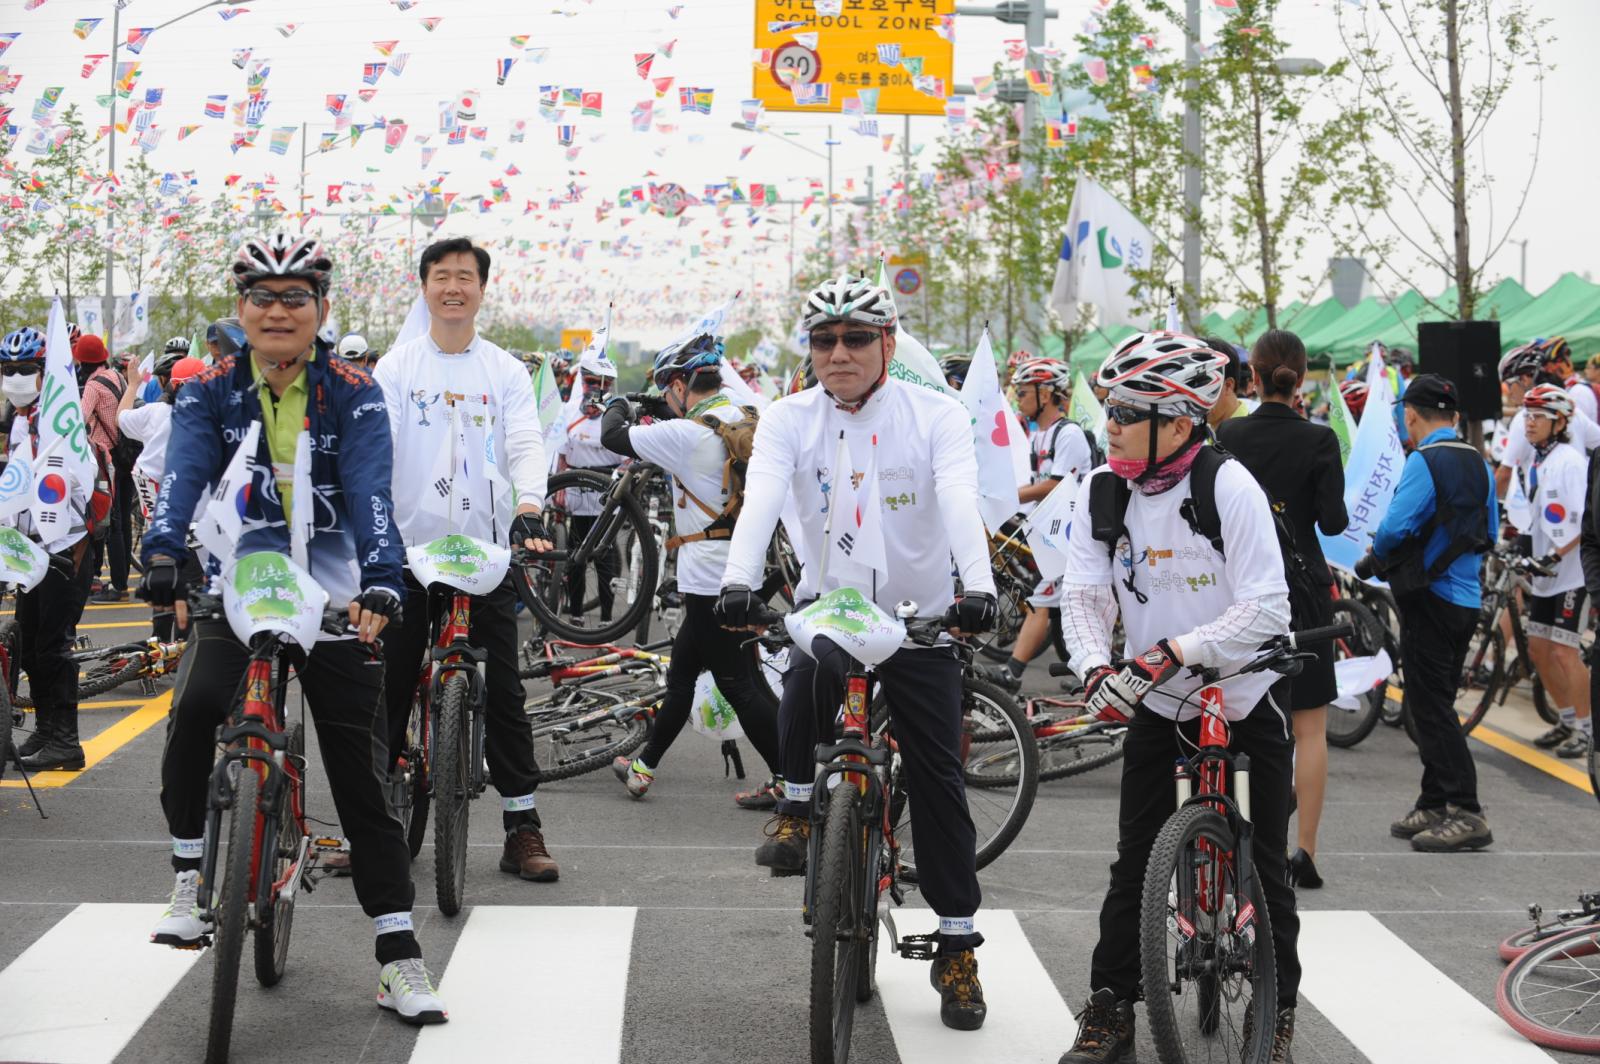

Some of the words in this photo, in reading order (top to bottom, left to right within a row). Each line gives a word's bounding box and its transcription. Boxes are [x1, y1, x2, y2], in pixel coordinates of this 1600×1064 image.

[878, 16, 934, 30] ZONE
[835, 72, 871, 86] 속도를
[163, 470, 177, 500] Tour
[157, 501, 170, 516] de
